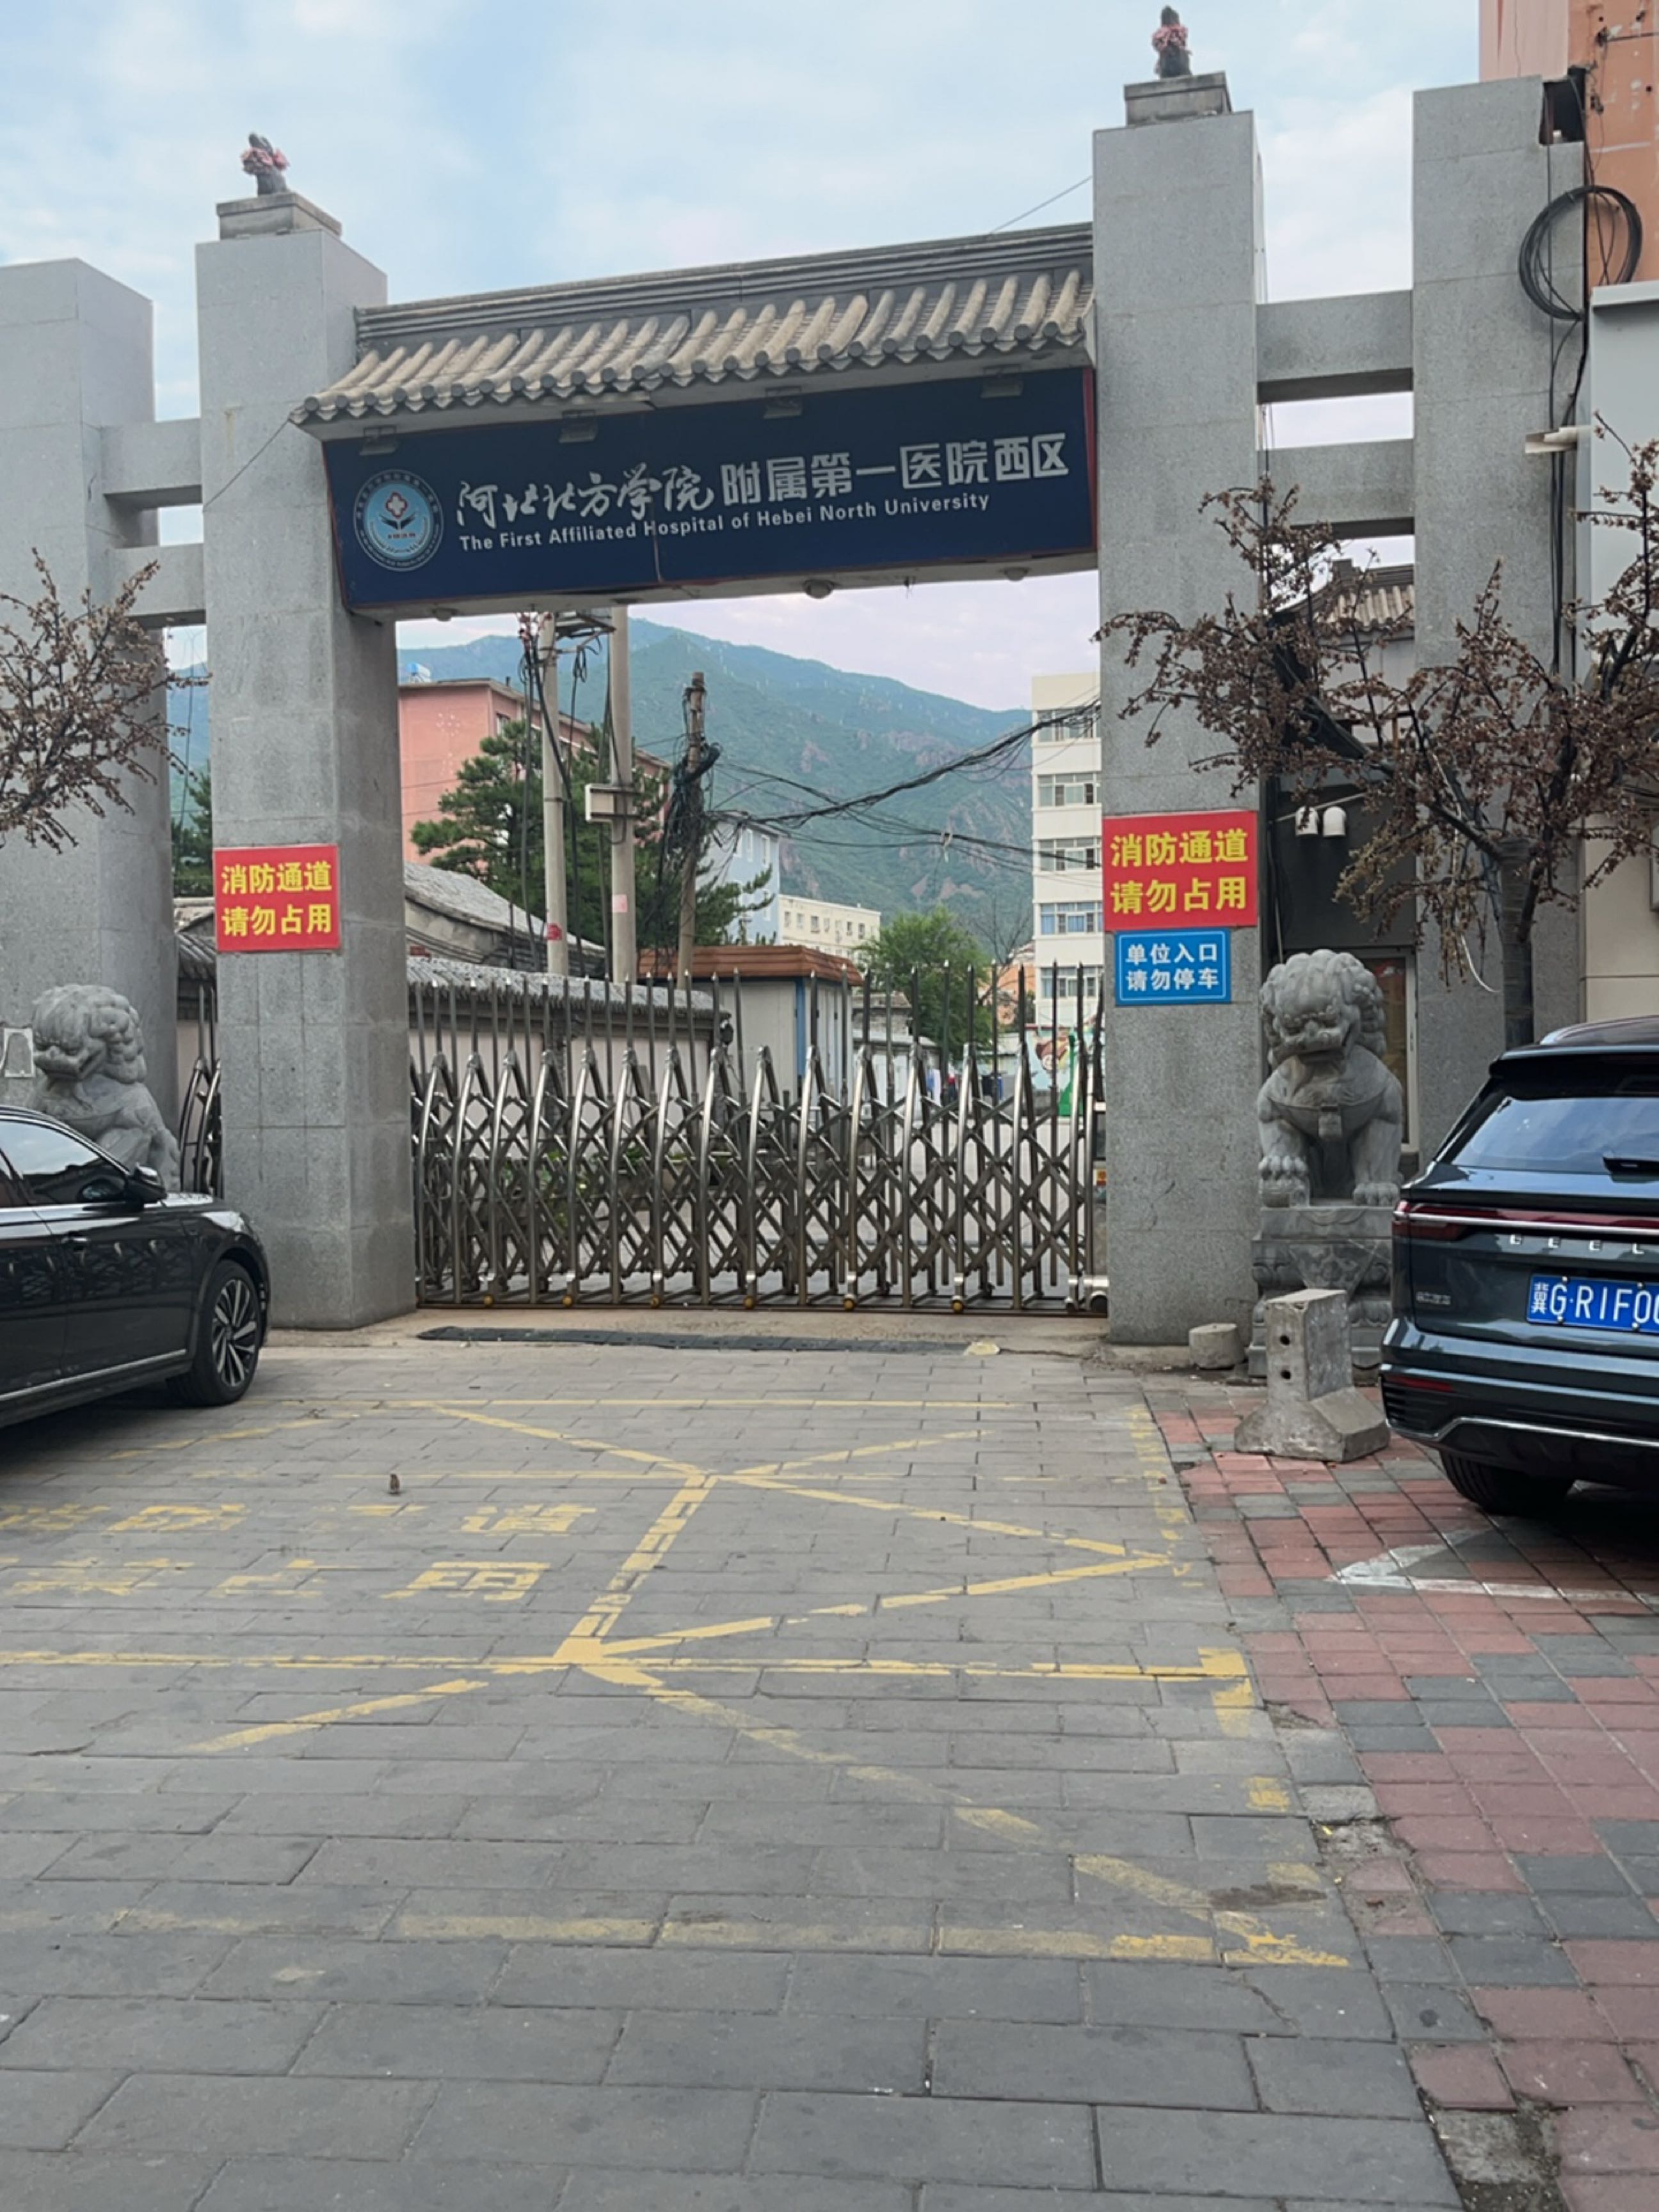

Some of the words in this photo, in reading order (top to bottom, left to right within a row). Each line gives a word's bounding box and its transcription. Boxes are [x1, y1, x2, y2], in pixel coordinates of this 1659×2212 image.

[460, 534, 493, 552] The
[501, 531, 541, 549] First
[549, 523, 636, 545] Affiliated
[644, 515, 723, 538] Hospital
[732, 513, 749, 528] of
[758, 507, 812, 527] Hebei
[820, 502, 876, 522] North
[885, 493, 990, 515] University
[1110, 828, 1247, 867] 消防通道
[221, 861, 332, 894] 消防通道
[1110, 876, 1246, 914] 请勿占用
[221, 904, 331, 936] 请勿占用
[1126, 943, 1217, 965] 单位入口
[1126, 968, 1219, 991] 请勿停车
